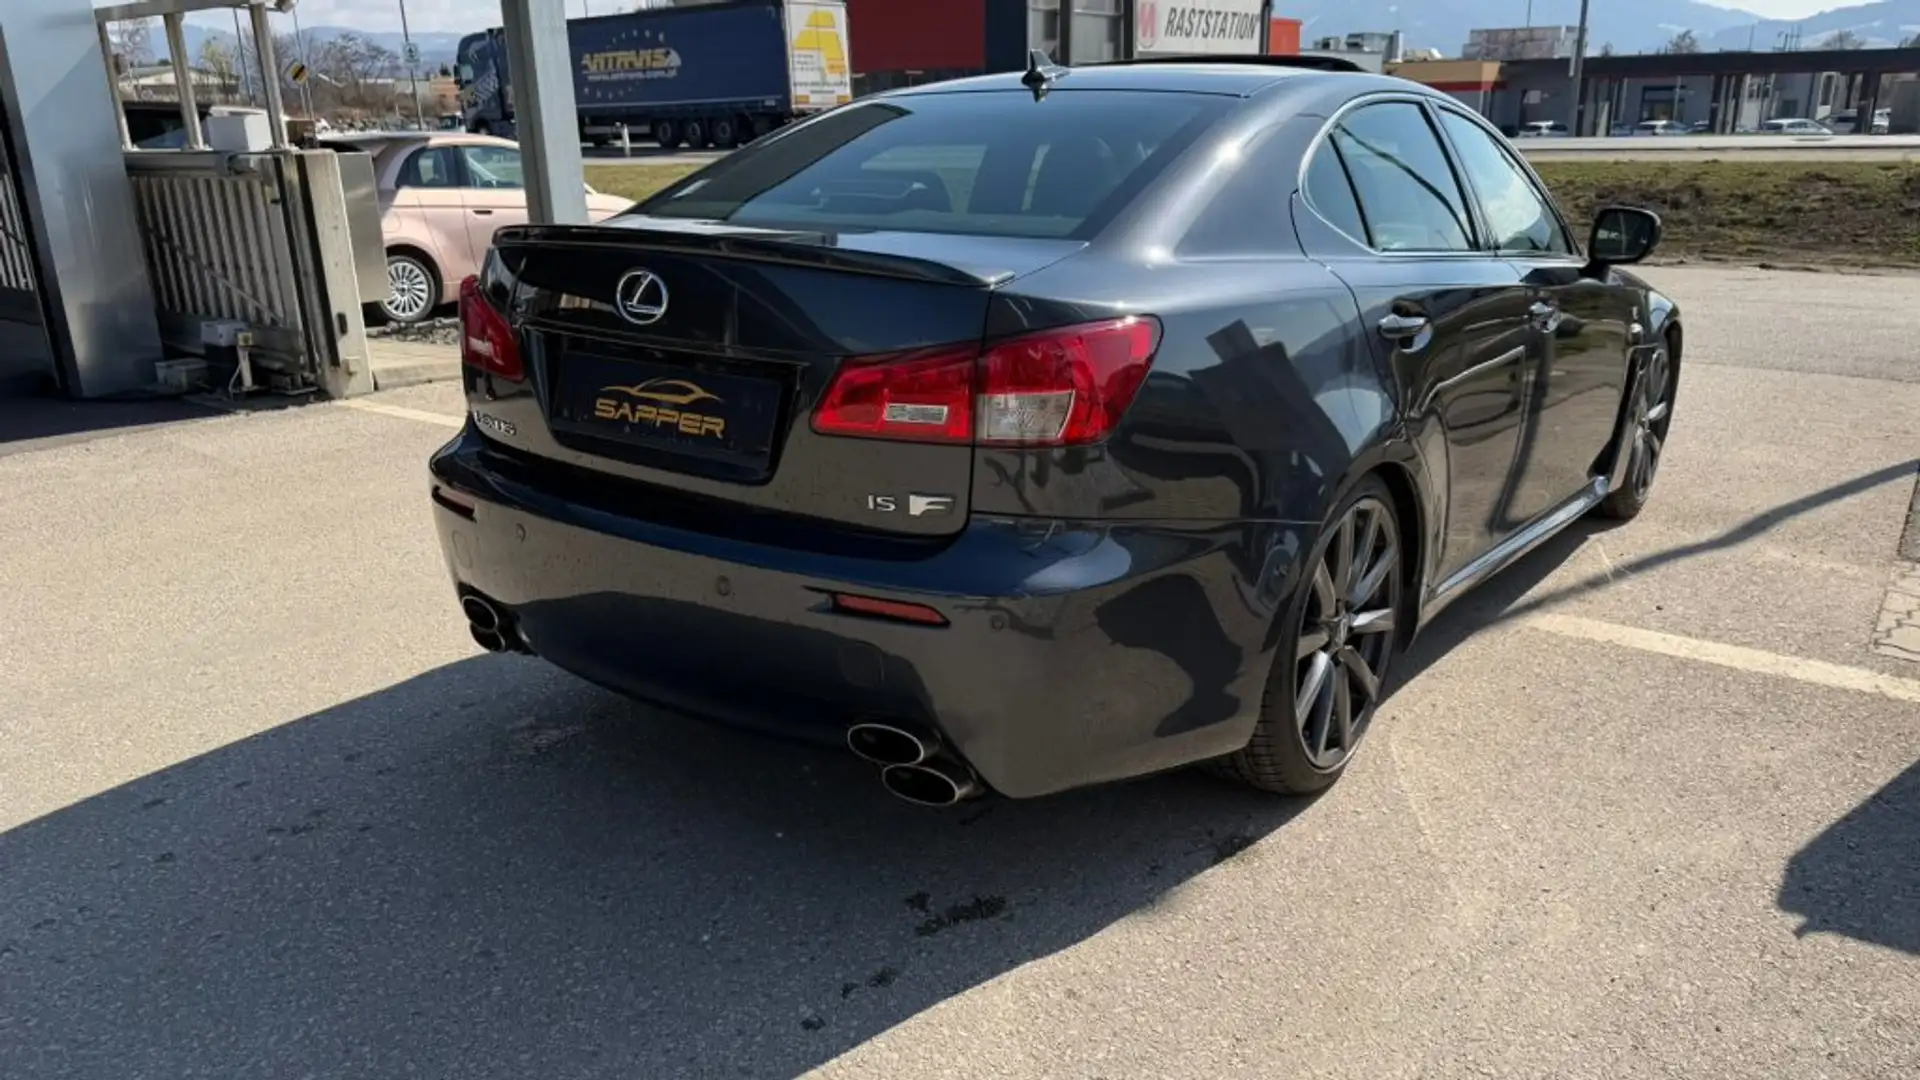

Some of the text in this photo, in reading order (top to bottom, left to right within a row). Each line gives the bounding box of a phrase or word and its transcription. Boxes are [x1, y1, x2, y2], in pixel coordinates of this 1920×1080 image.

[1164, 7, 1259, 39] RASTSTATION
[595, 398, 725, 439] SAPPER
[868, 495, 896, 511] IS
